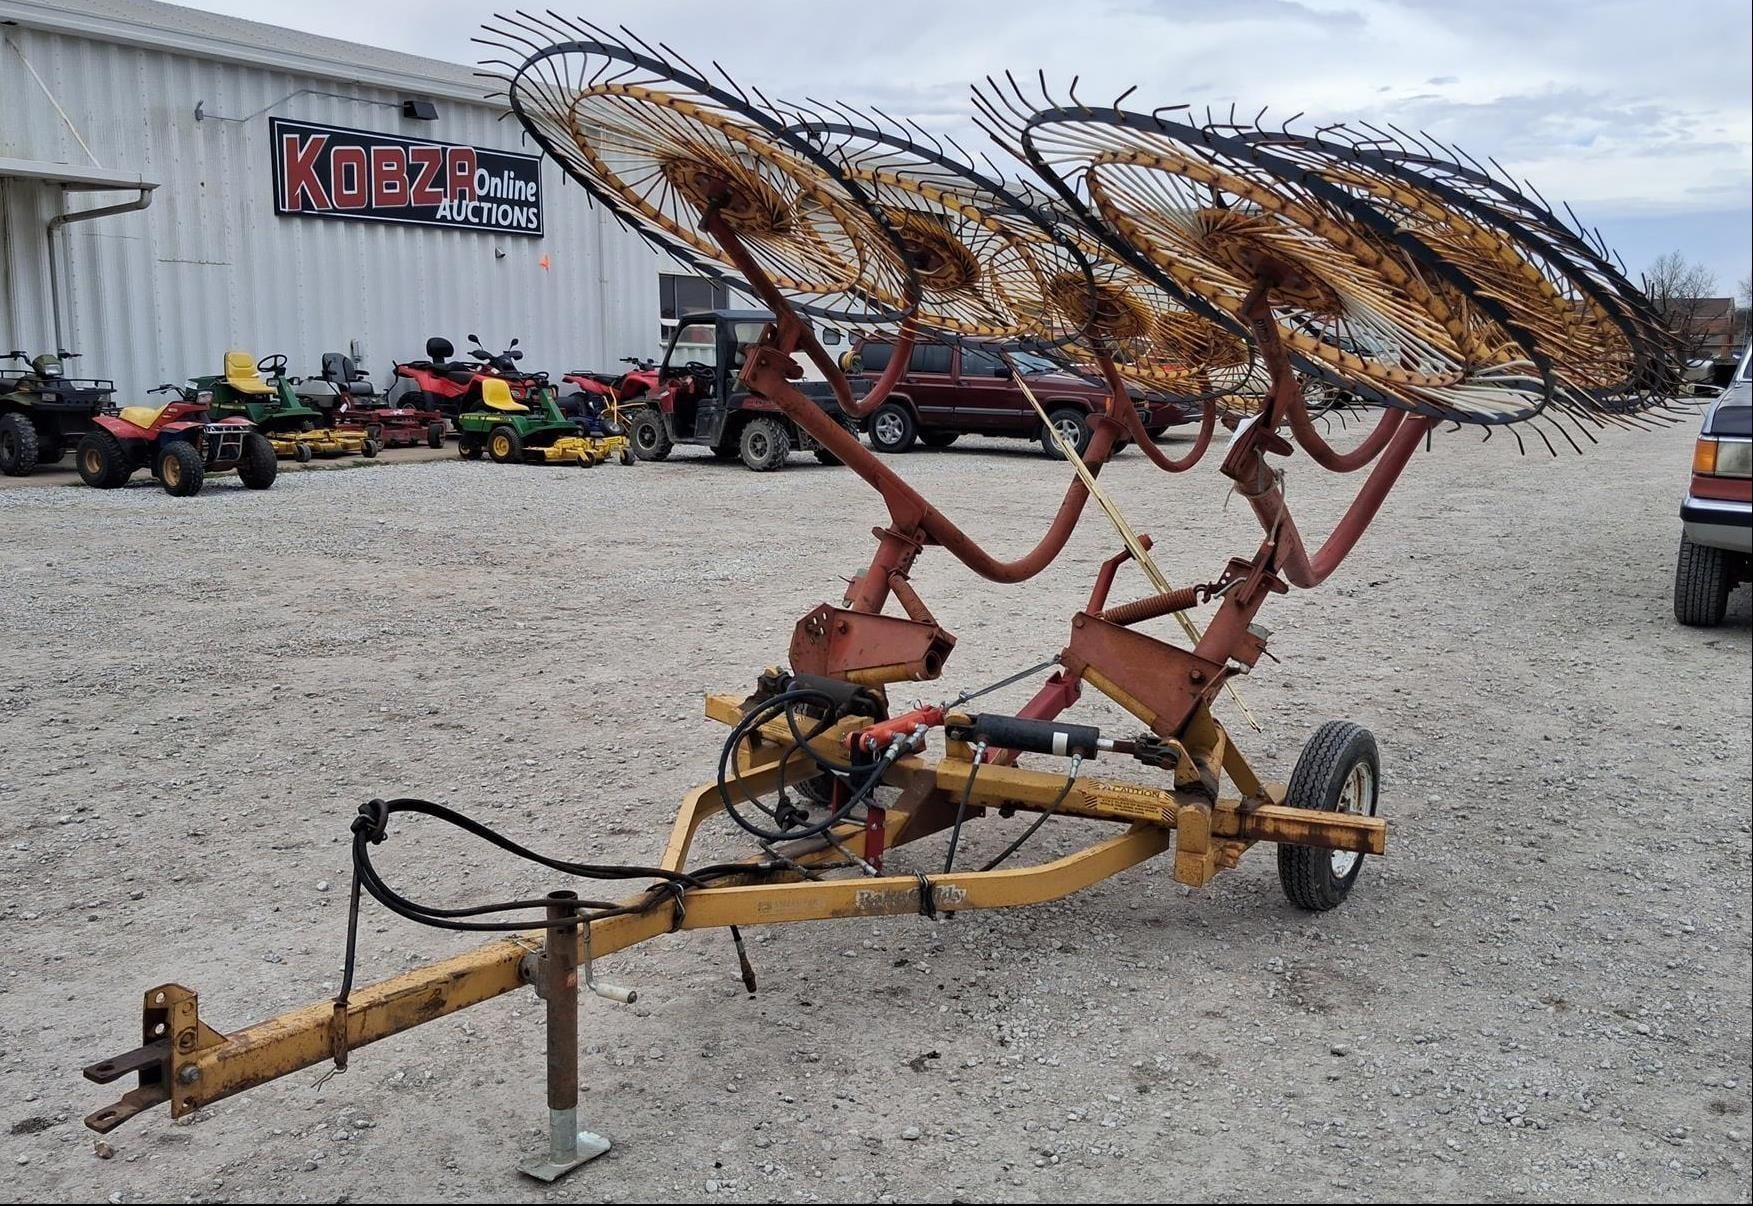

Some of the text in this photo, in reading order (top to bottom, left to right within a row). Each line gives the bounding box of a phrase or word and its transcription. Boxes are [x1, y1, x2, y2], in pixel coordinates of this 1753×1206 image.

[282, 133, 478, 212] KOBZA
[473, 167, 536, 202] Online
[435, 198, 539, 229] AUCTIONS
[1112, 785, 1160, 798] CAUTION
